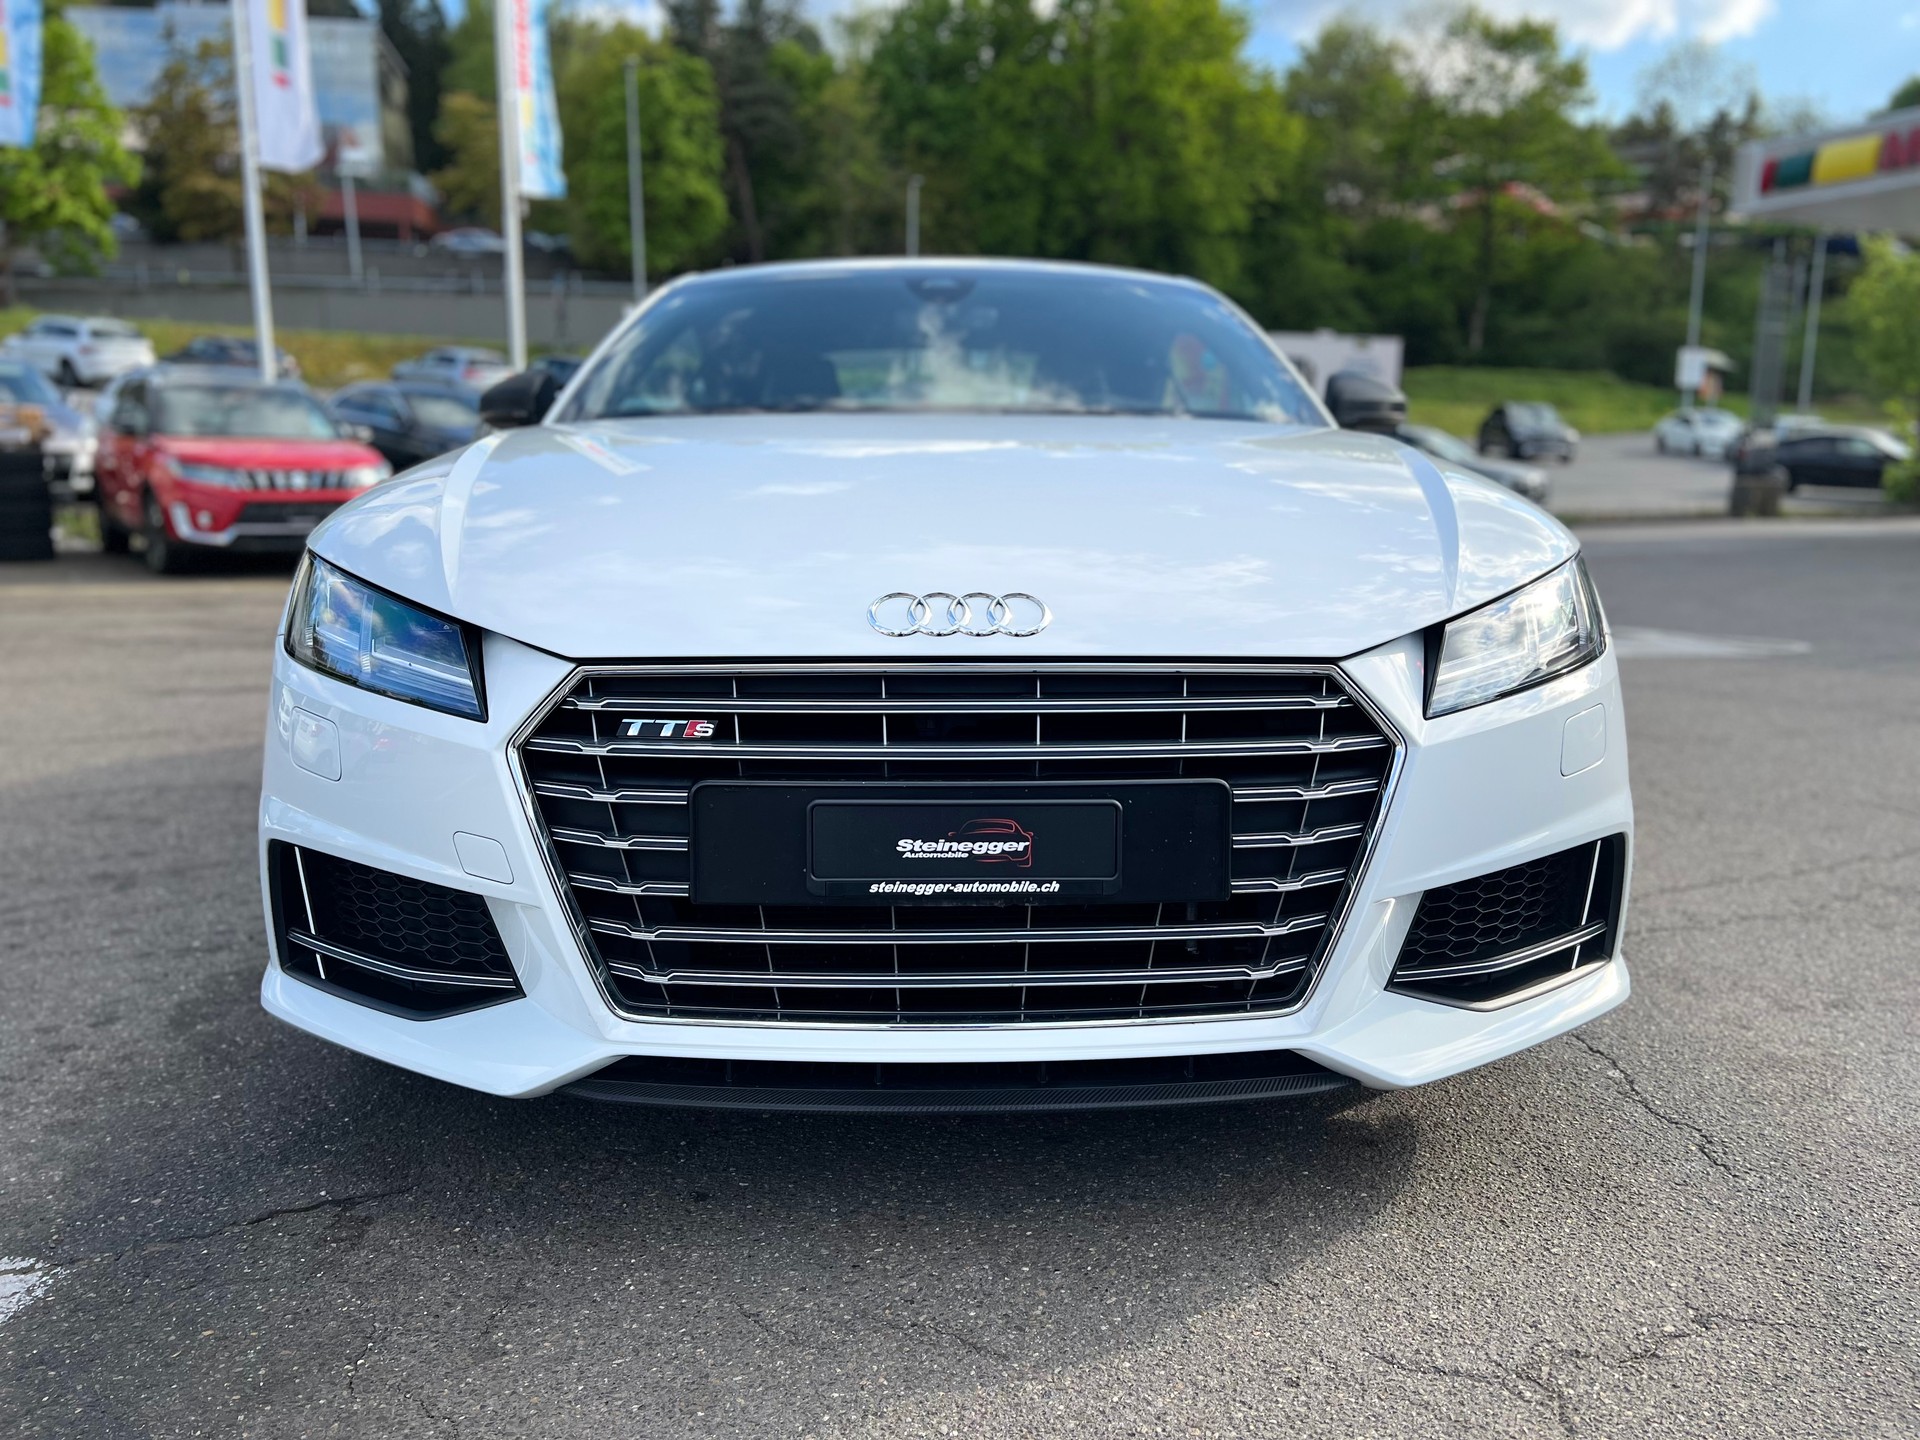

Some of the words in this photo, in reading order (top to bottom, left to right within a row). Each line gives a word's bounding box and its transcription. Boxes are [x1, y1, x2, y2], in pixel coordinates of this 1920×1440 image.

[621, 718, 715, 738] TTS
[895, 838, 1030, 855] Steinegger
[902, 851, 970, 859] Automobile
[868, 880, 1061, 896] steinegger-automobile.ch
